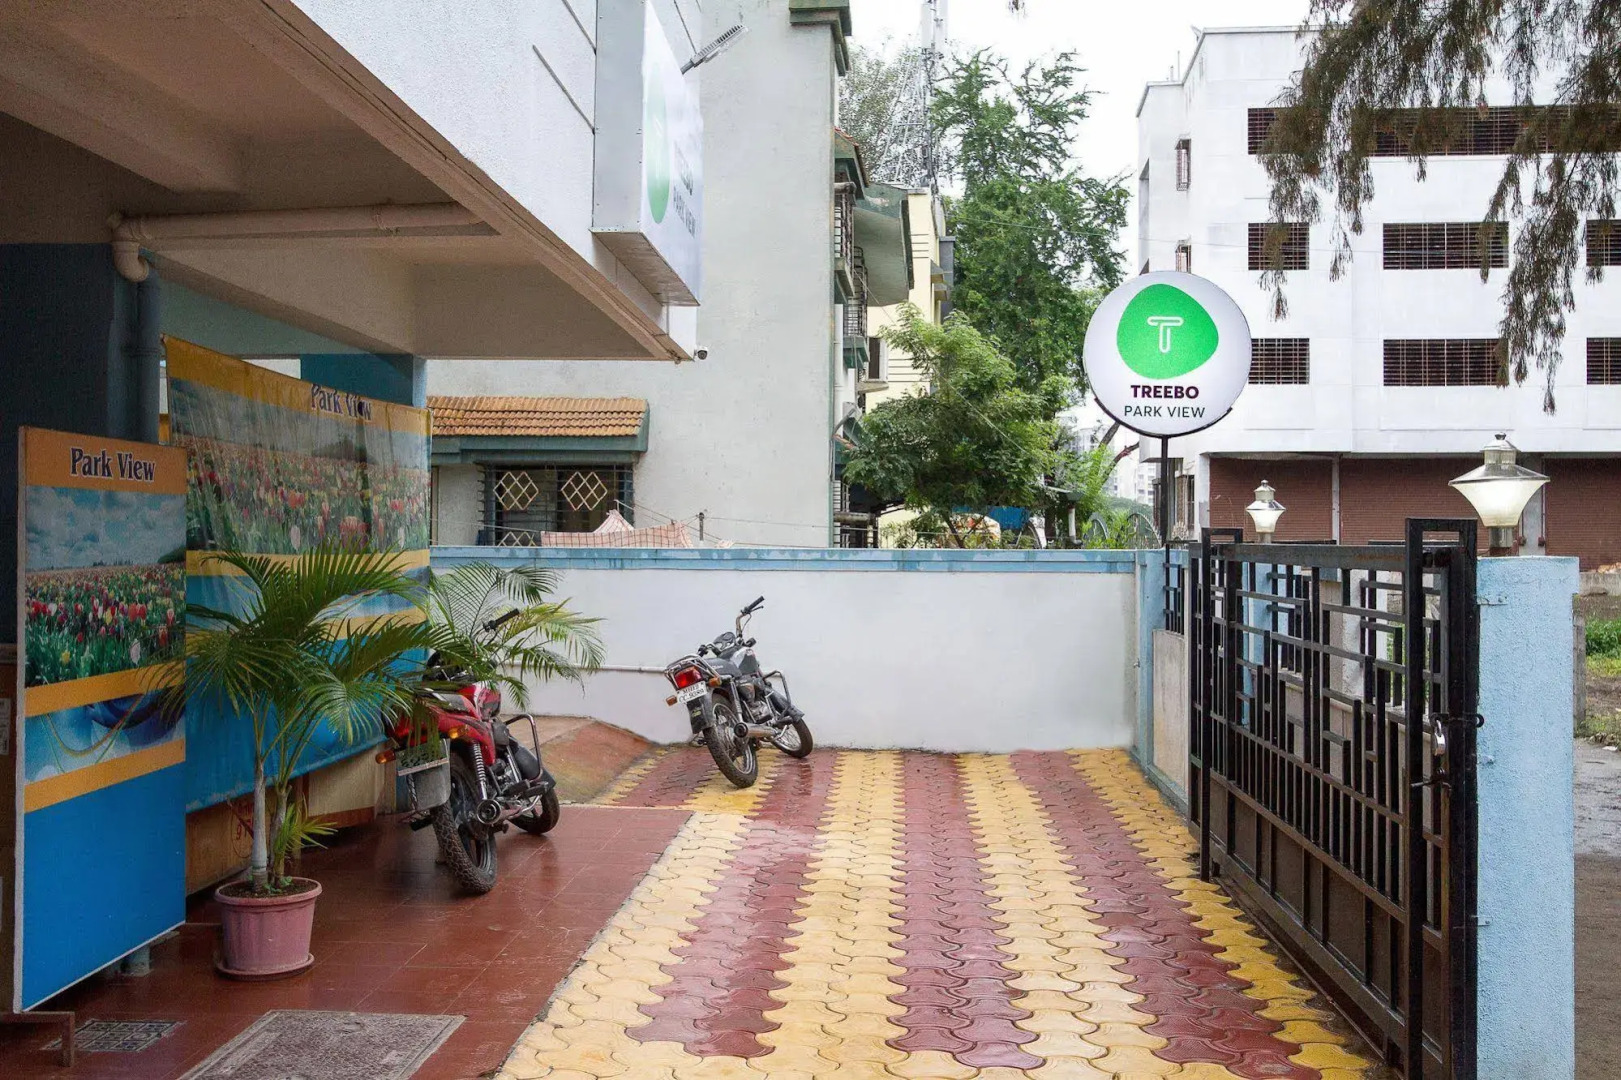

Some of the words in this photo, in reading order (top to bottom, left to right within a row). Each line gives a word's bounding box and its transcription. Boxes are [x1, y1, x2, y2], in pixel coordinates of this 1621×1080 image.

[1147, 316, 1184, 353] T
[310, 383, 344, 415] Park
[345, 392, 372, 421] Viw
[1130, 385, 1199, 399] TREEBO
[1124, 405, 1162, 417] PARK
[1167, 406, 1206, 418] VIEW
[70, 447, 113, 478] Park
[117, 452, 156, 481] View
